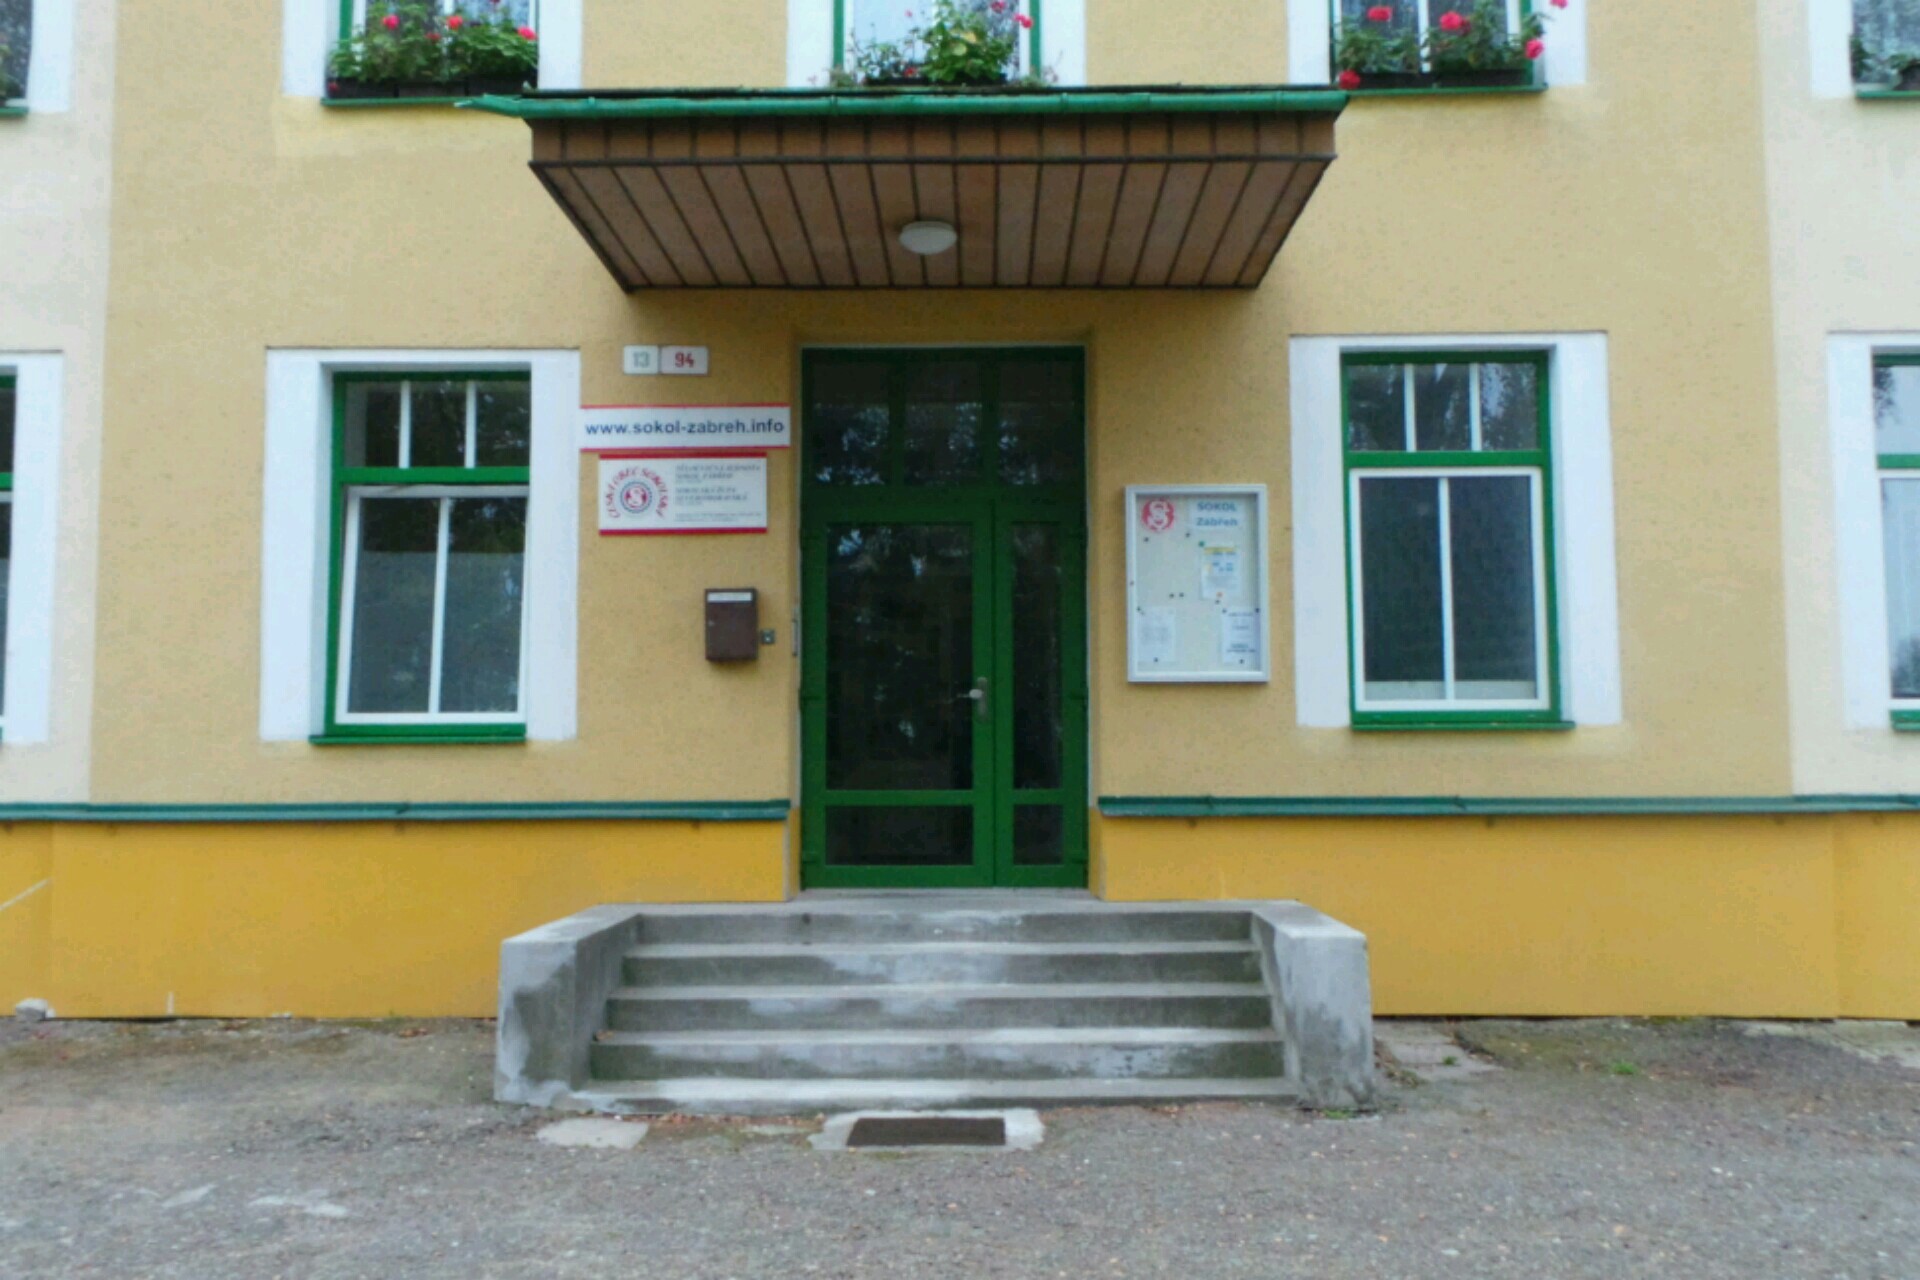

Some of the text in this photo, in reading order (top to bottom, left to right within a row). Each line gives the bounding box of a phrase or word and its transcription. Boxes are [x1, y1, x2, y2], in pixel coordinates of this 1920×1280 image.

[633, 351, 650, 368] 13
[675, 351, 695, 368] 94
[585, 418, 785, 435] www.sokol-zabreh.info
[1196, 501, 1238, 512] SOKOL
